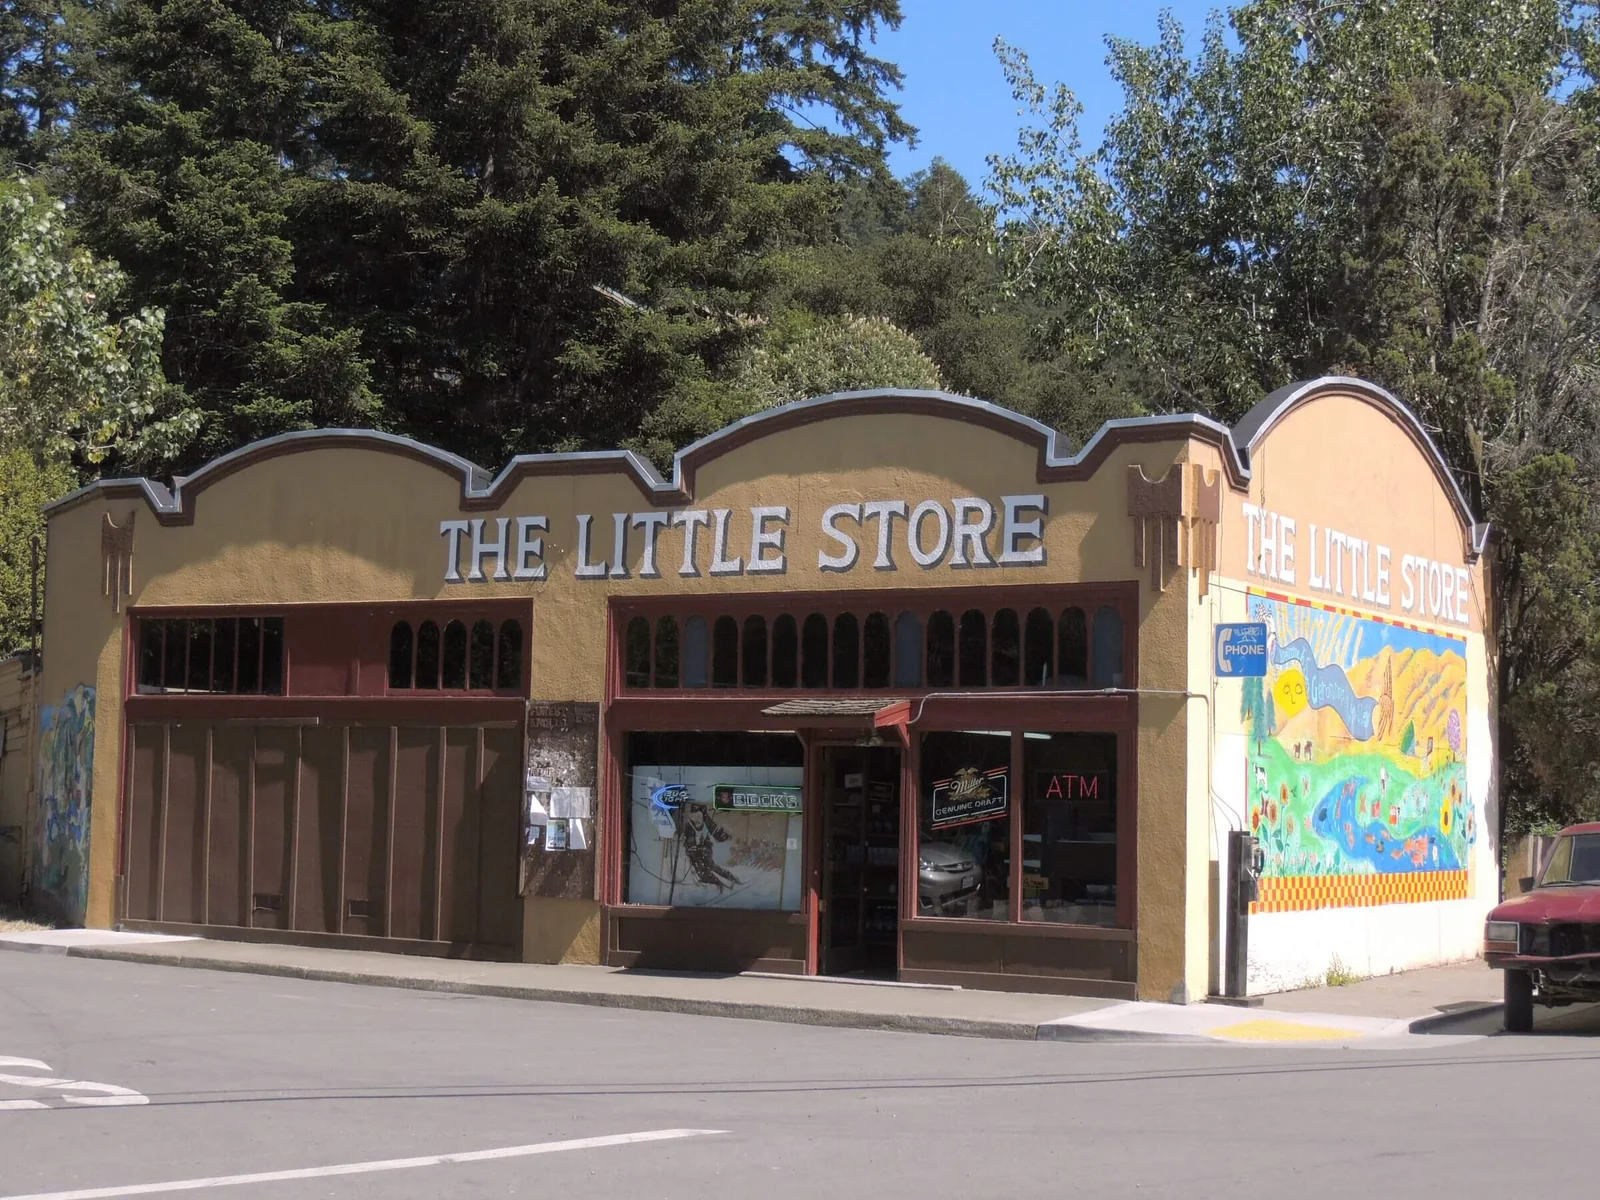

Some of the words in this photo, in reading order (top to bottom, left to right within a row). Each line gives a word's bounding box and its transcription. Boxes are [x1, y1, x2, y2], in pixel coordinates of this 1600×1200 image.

[440, 516, 549, 582] THE
[574, 506, 790, 580] LITTLE
[818, 494, 1049, 572] STORE
[1242, 502, 1297, 585] THE
[1308, 524, 1392, 607] LITTLE
[1401, 554, 1470, 625] STORE
[1225, 644, 1265, 656] PHONE
[664, 789, 687, 797] BUD
[950, 777, 985, 797] Miller
[1045, 774, 1099, 800] ATM
[732, 791, 798, 809] BECK'S
[935, 801, 973, 816] GENUINE
[974, 796, 1003, 809] DRAFT
